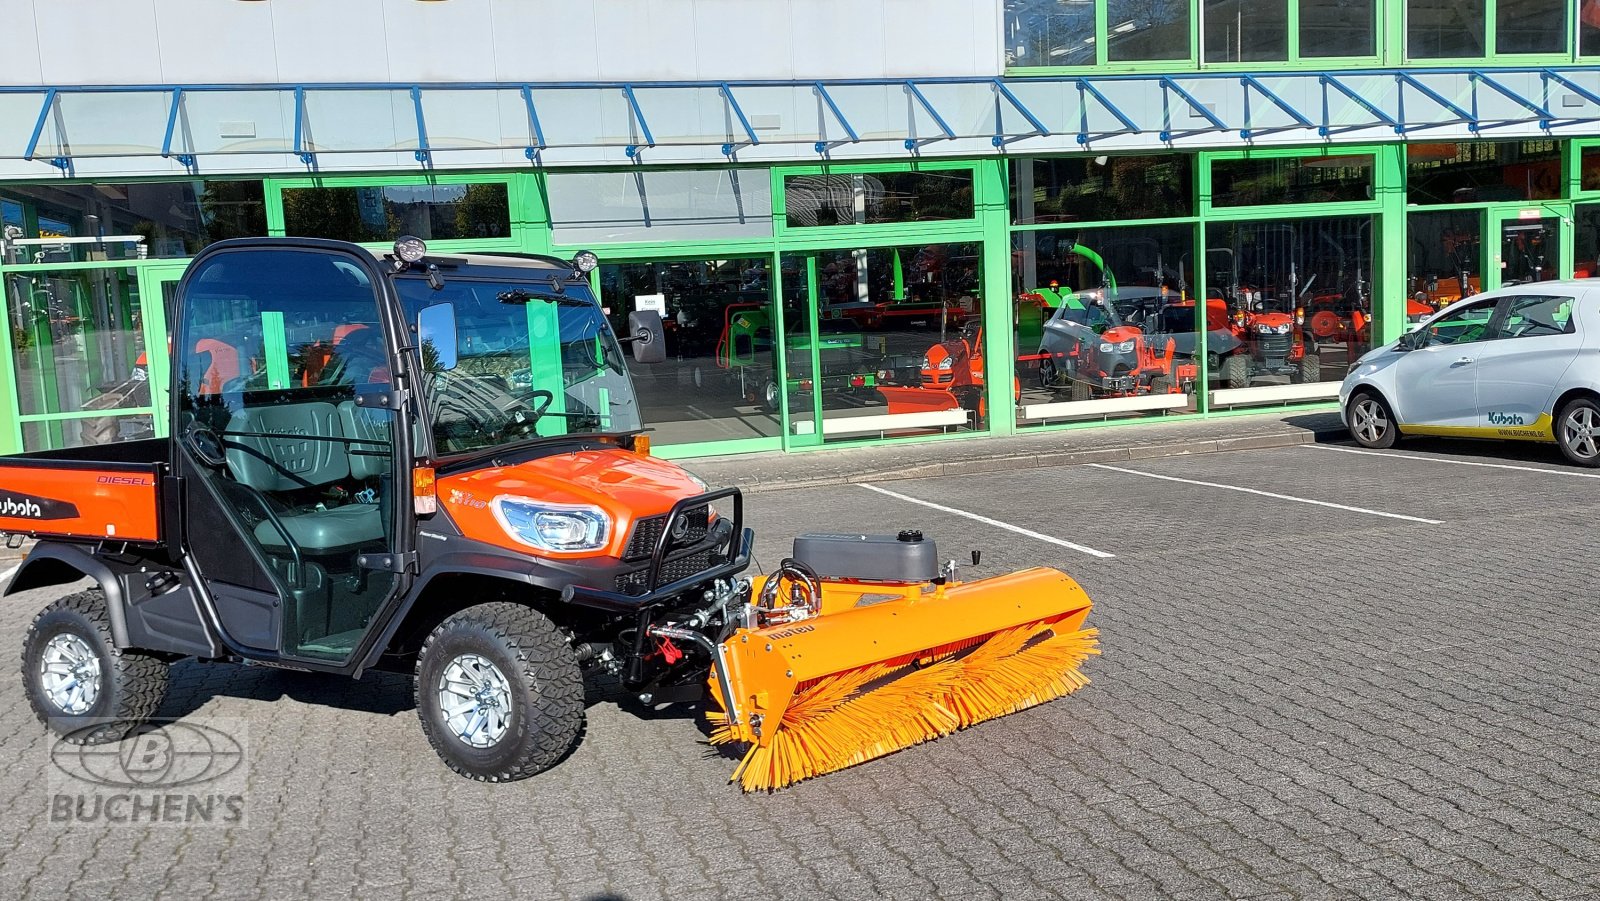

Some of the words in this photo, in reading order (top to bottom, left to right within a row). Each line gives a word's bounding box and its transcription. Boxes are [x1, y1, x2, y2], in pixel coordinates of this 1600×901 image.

[1487, 411, 1524, 426] Kubota
[97, 475, 150, 487] DIESEL
[0, 497, 41, 517] ubota
[767, 624, 816, 641] matev
